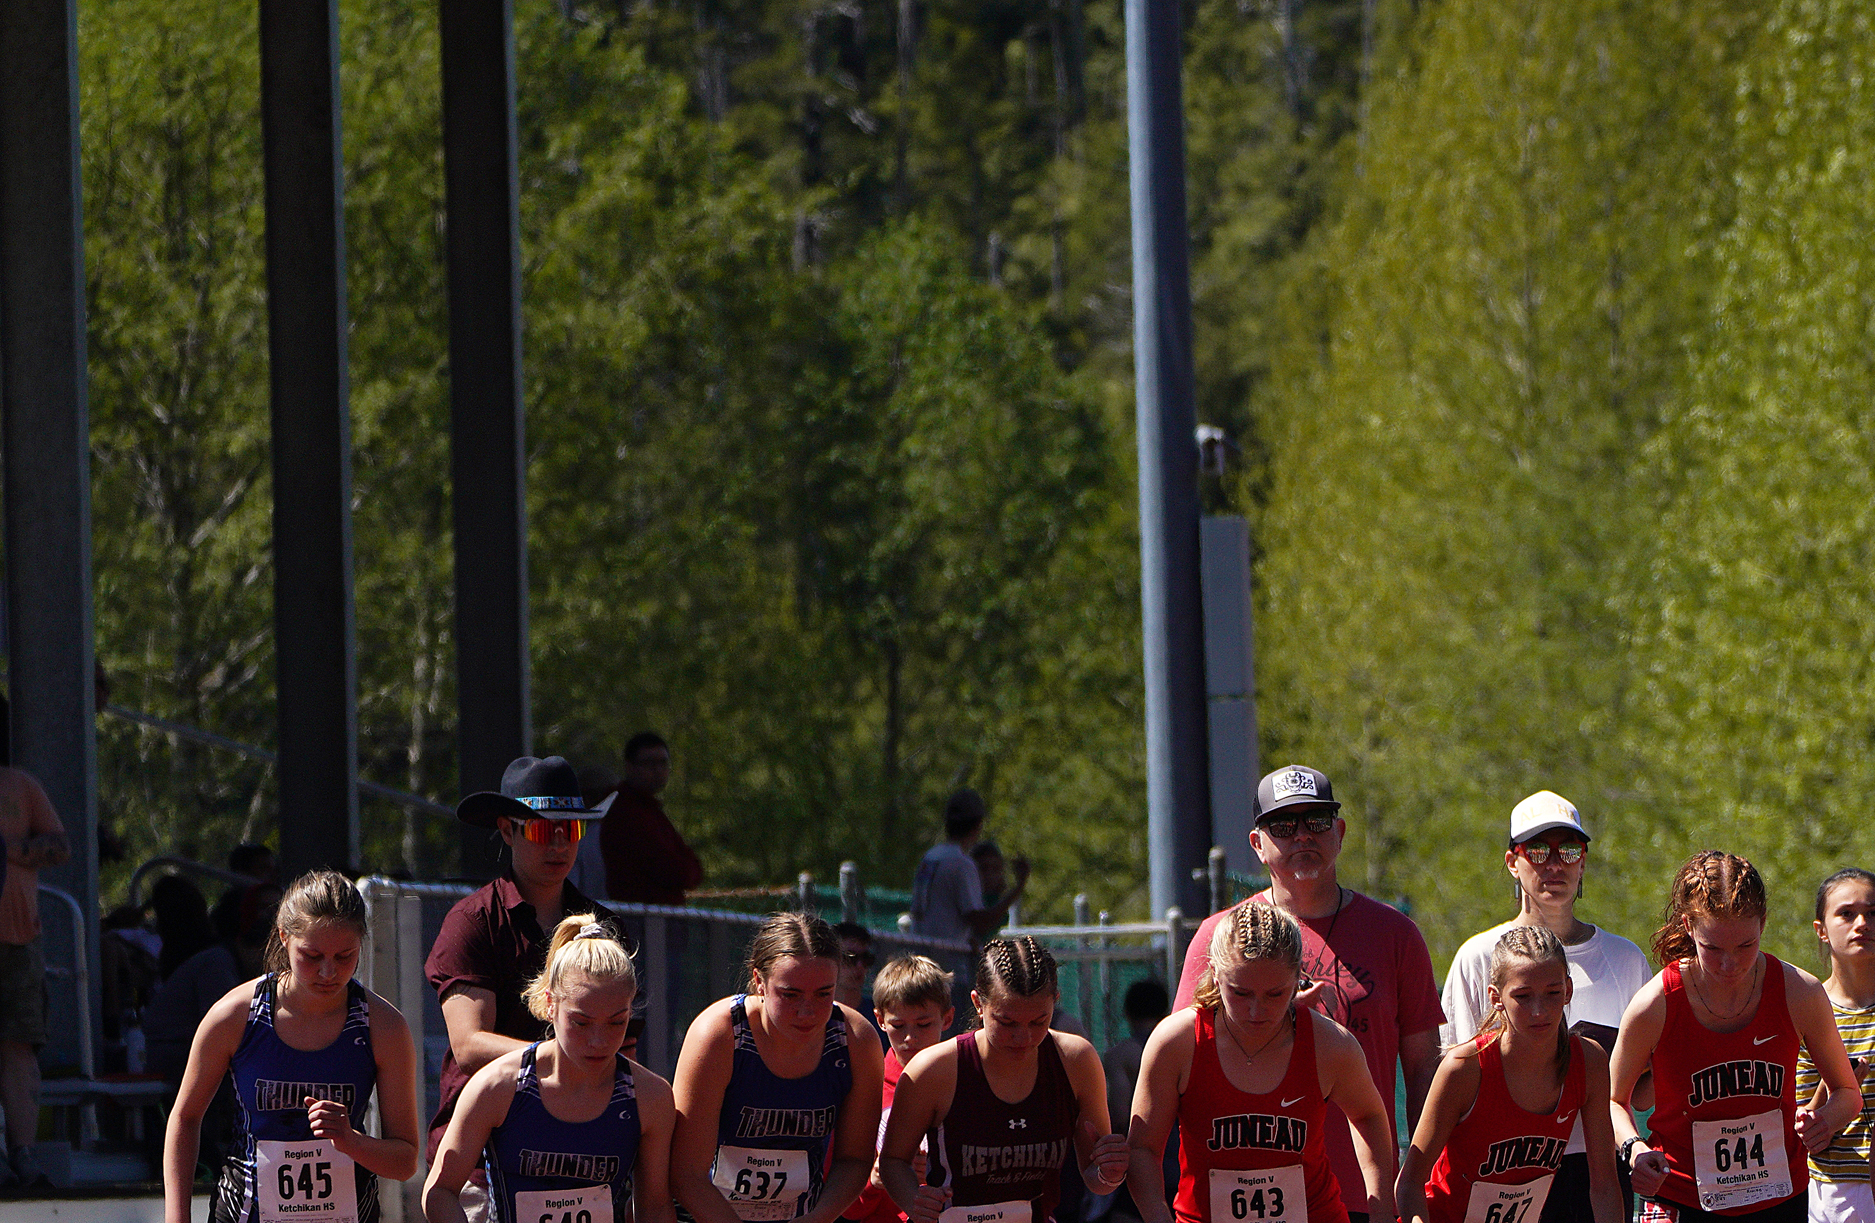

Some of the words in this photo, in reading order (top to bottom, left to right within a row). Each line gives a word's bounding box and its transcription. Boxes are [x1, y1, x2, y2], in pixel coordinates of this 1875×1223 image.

[1688, 1059, 1785, 1108] JUNEAU
[736, 1105, 836, 1138] THUNDER
[1721, 1125, 1748, 1135] Region
[1750, 1122, 1756, 1130] V
[1206, 1113, 1307, 1154] JUNEAU
[284, 1150, 314, 1160] Region
[316, 1148, 322, 1157] V
[747, 1156, 775, 1167] Region
[776, 1158, 782, 1166] V
[1478, 1135, 1568, 1177] JUNEAU
[1714, 1133, 1766, 1172] 644
[519, 1148, 620, 1182] THUNDER
[278, 1162, 333, 1200] 645
[734, 1168, 788, 1200] 637
[1238, 1176, 1266, 1186] Region
[1716, 1174, 1756, 1185] Ketchikan
[1758, 1170, 1769, 1179] HS
[545, 1199, 575, 1210] Region
[577, 1196, 583, 1205] V
[1230, 1187, 1284, 1220] 643
[1498, 1191, 1525, 1200] Region
[278, 1203, 321, 1213] Ketchikan
[323, 1202, 336, 1211] HS
[967, 1213, 996, 1223] Region
